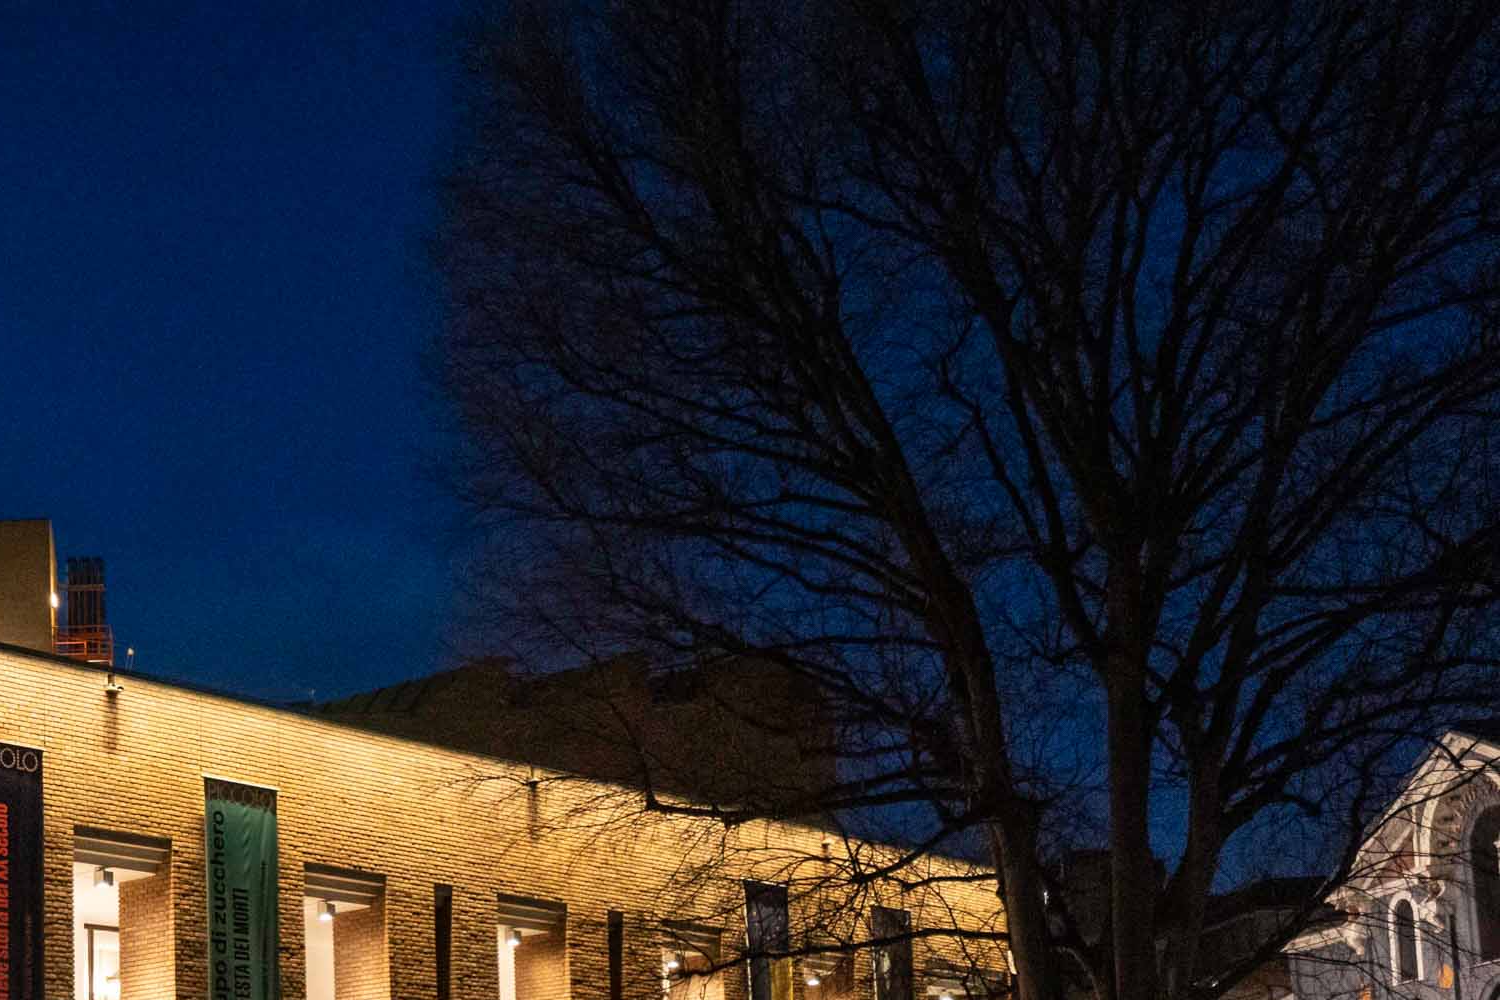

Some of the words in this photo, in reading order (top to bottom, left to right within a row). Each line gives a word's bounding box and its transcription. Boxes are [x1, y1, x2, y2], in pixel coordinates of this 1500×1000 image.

[210, 810, 226, 925] zucchero
[211, 931, 227, 955] di
[234, 937, 250, 961] DEI
